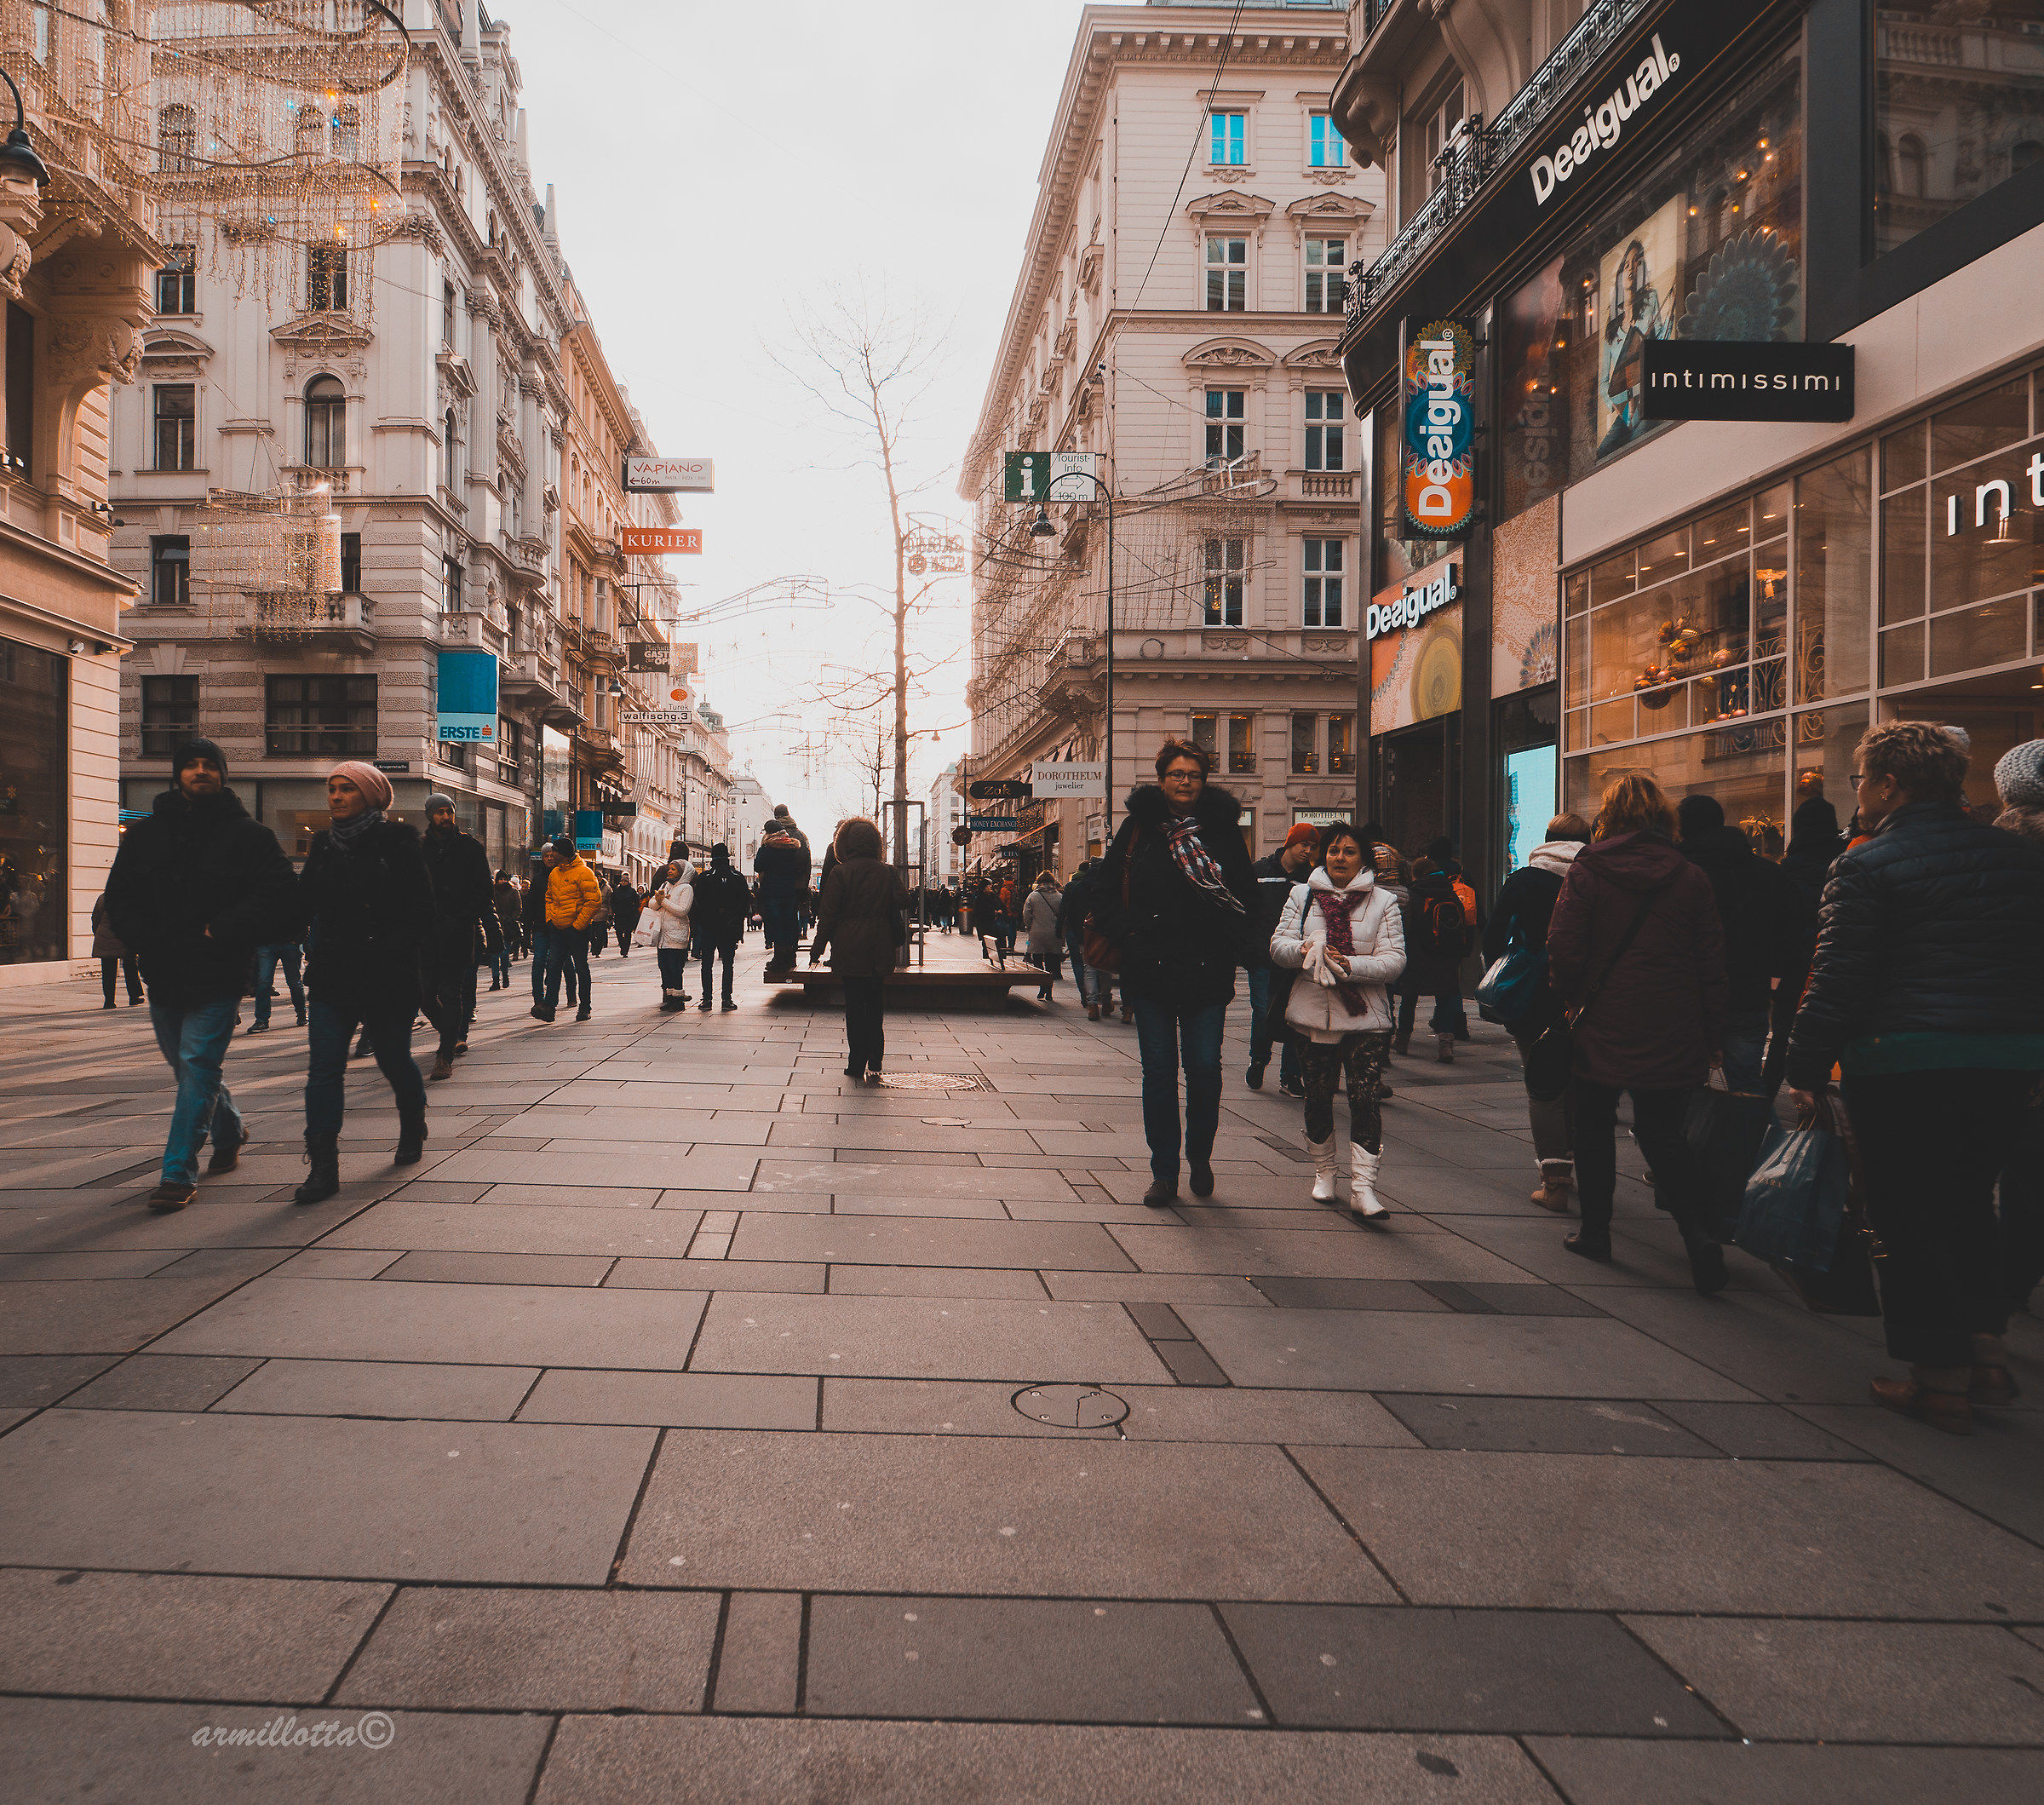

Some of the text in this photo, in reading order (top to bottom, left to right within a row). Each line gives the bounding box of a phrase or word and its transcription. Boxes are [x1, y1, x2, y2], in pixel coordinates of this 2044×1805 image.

[1651, 369, 1840, 391] intimissimi
[1064, 463, 1082, 473] Info
[627, 534, 699, 548] KURIER
[644, 650, 669, 658] GAST
[623, 712, 688, 721] walfischg.3
[439, 726, 480, 739] ERSTE
[1037, 771, 1102, 780] DOROTHEUM
[1054, 782, 1084, 790] juwelier
